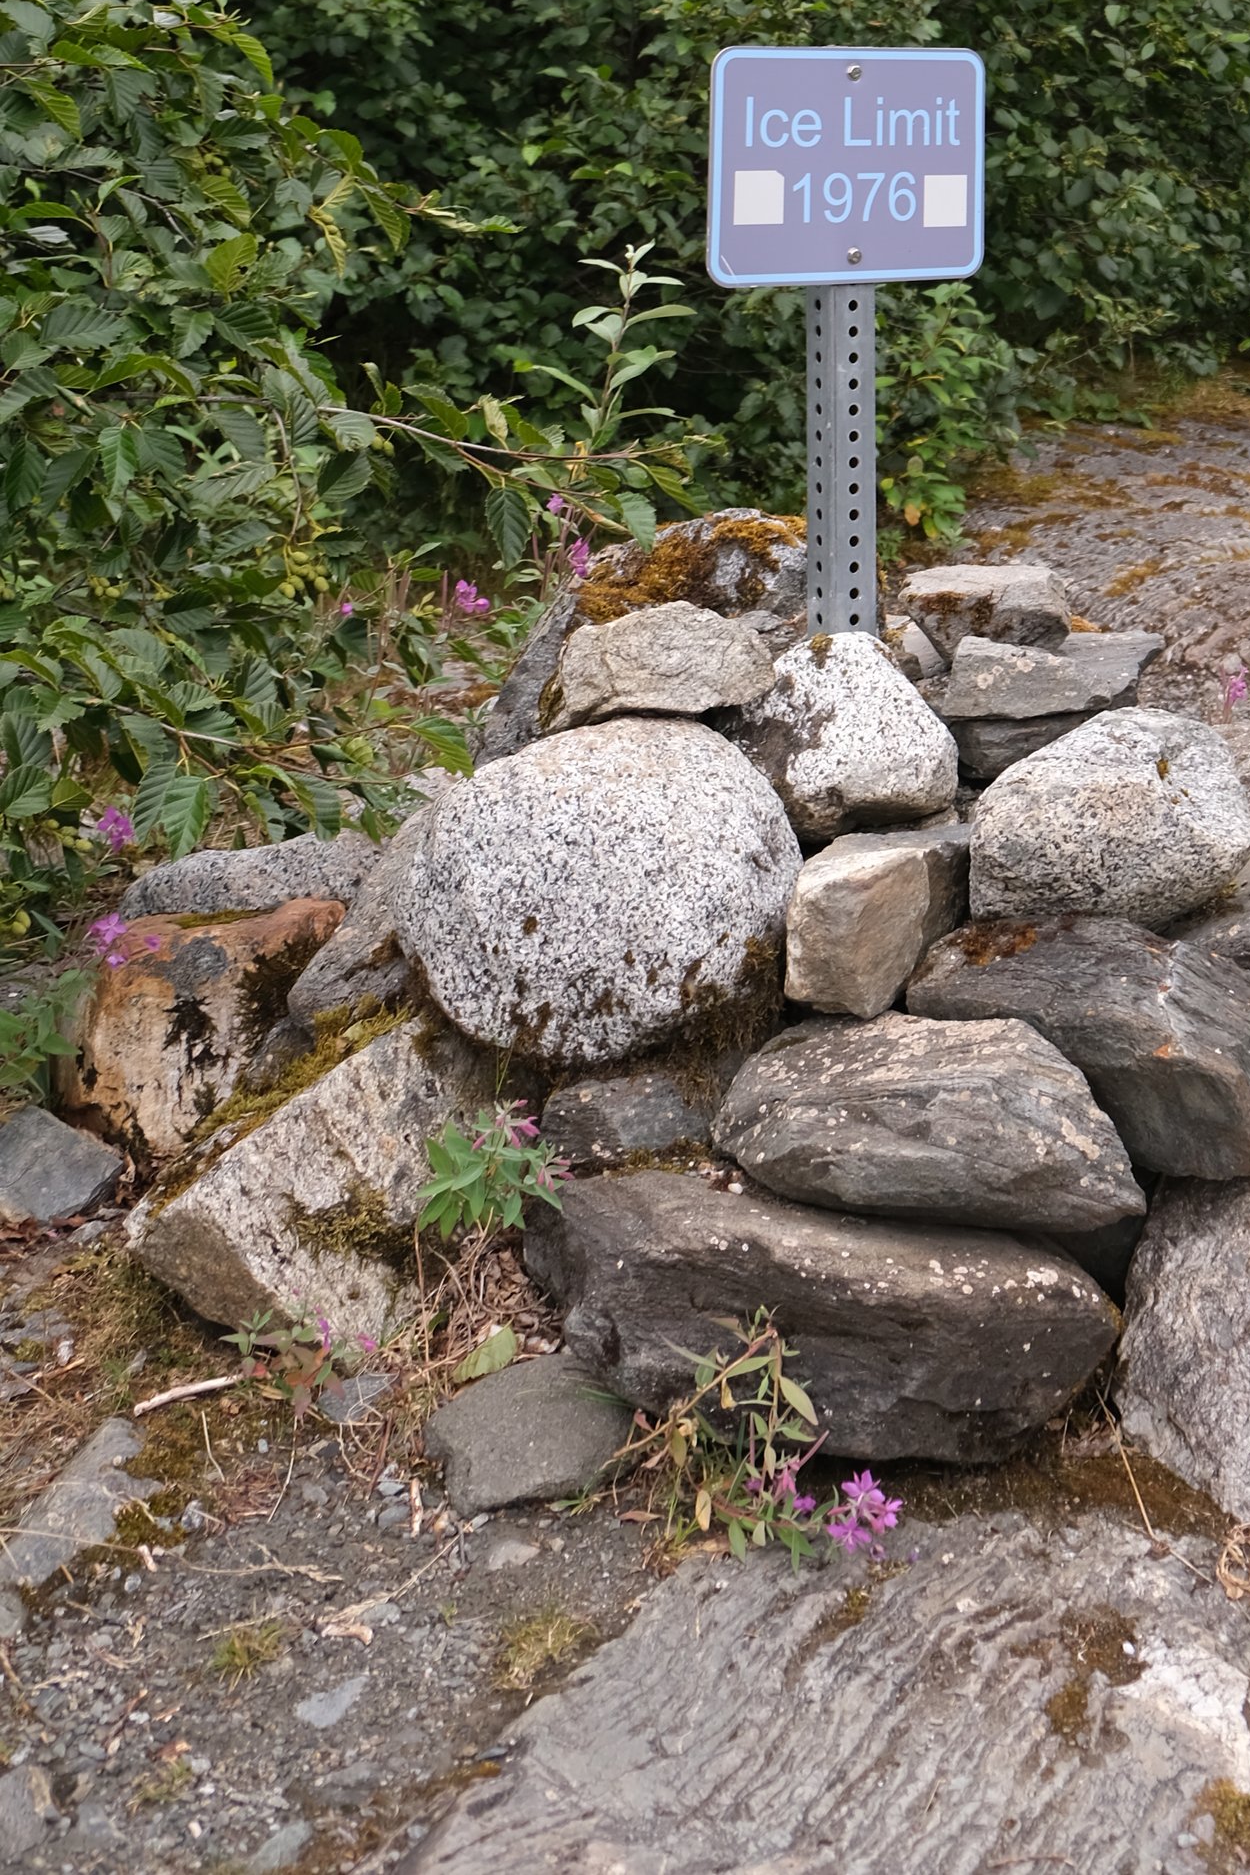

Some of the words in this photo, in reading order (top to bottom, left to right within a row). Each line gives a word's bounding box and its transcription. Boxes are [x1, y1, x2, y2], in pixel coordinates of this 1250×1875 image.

[745, 96, 823, 147] Ice
[844, 96, 961, 146] Limit
[792, 171, 917, 223] 1976
